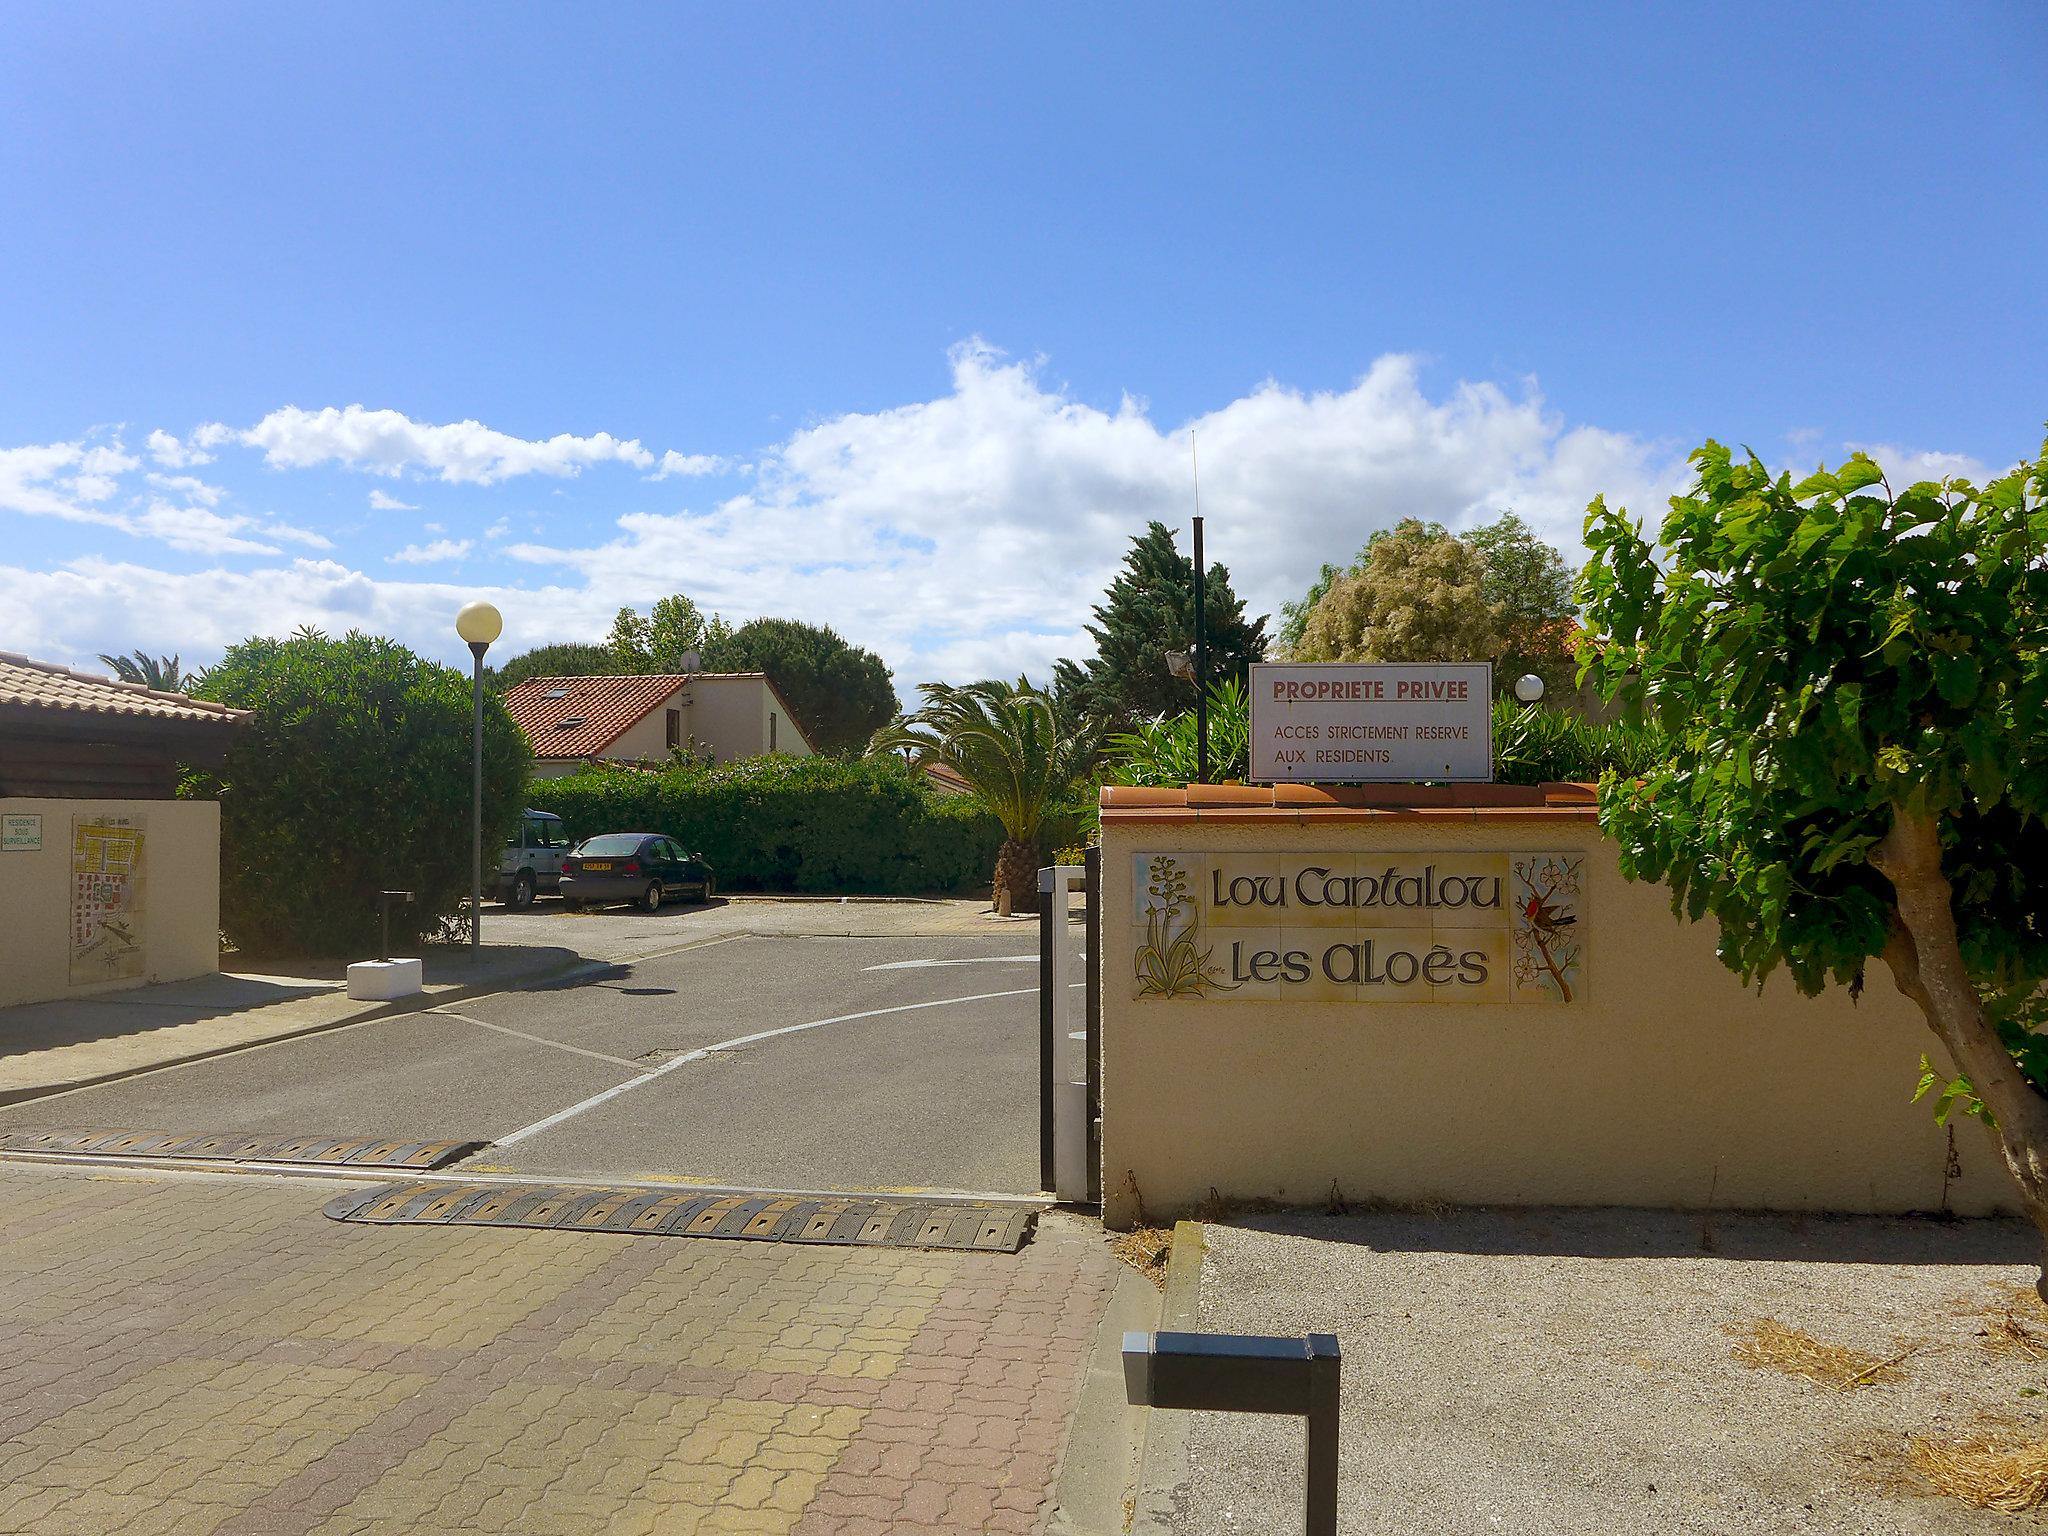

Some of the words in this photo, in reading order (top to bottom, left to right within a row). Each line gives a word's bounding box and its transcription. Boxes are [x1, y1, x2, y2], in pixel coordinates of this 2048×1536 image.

[1273, 681, 1384, 699] PROPRIETE
[1397, 681, 1468, 699] PRIVEE
[1274, 726, 1320, 740] ACCES
[1327, 726, 1409, 740] STRICTEMENT
[1415, 726, 1468, 740] RESERVE
[1274, 750, 1306, 763] AUX
